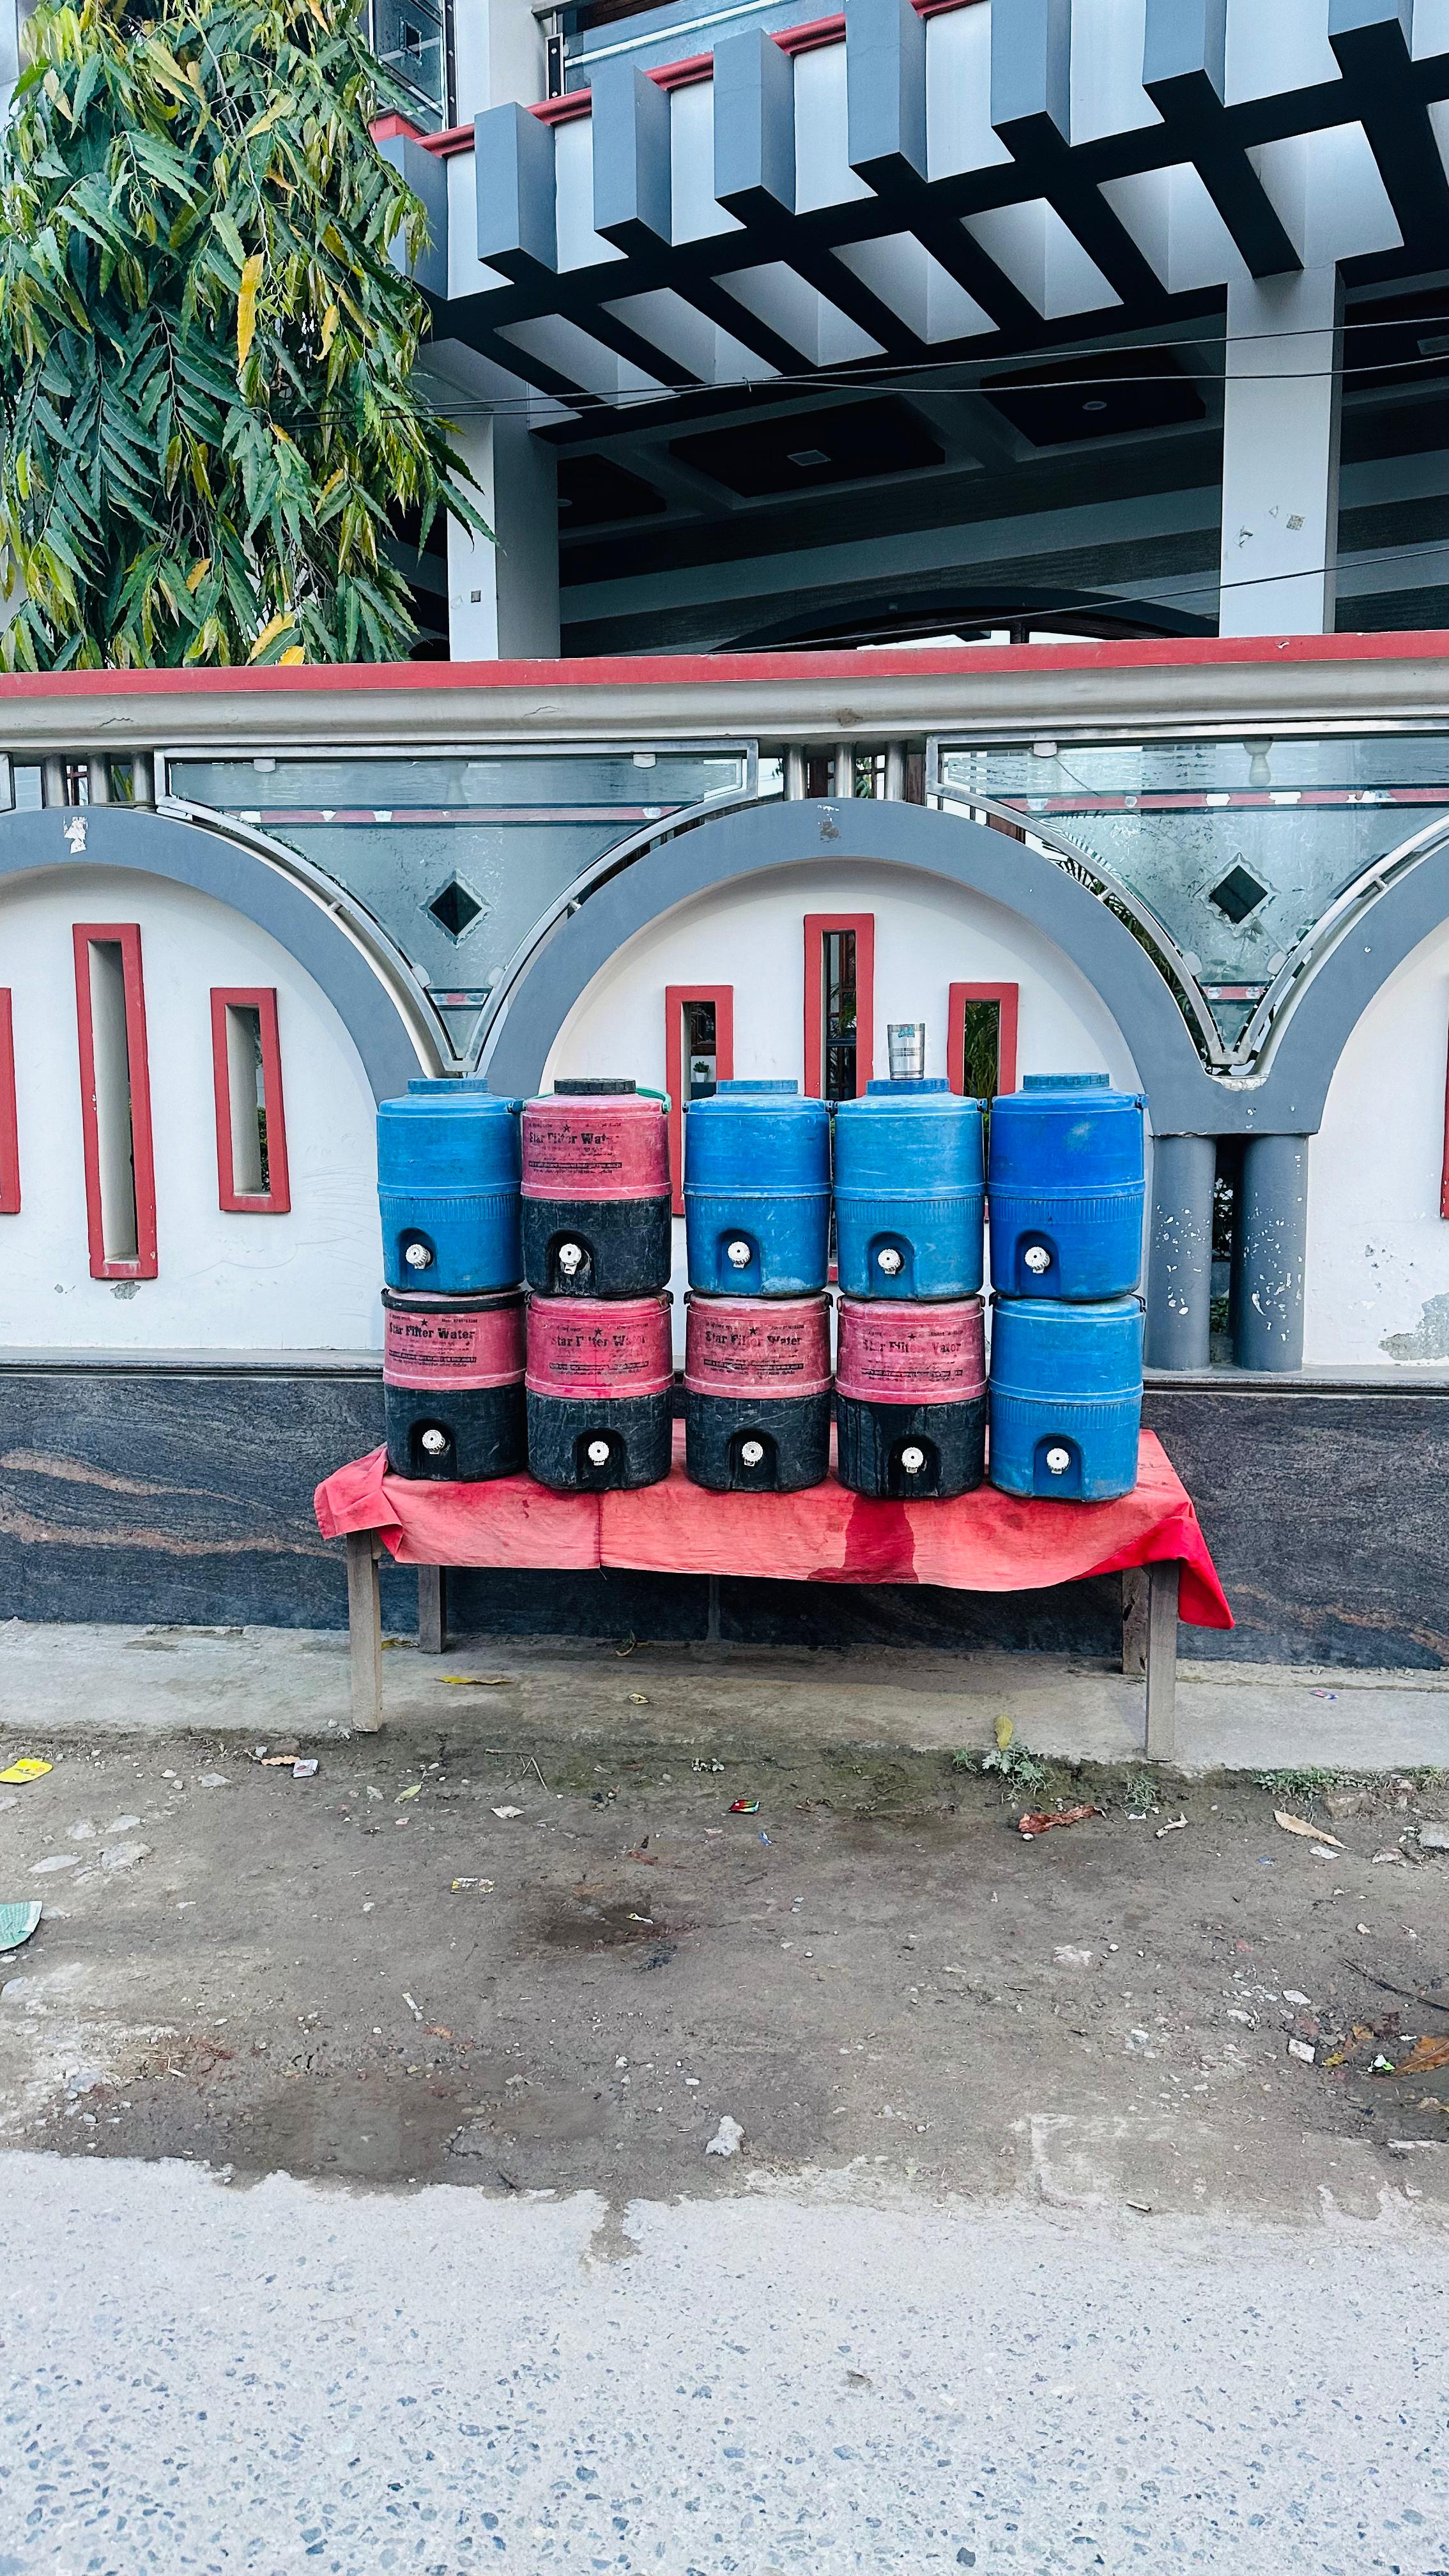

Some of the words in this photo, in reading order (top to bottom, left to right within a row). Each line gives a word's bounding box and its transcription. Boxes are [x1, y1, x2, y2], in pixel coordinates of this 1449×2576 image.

[389, 1322, 403, 1335] Star
[406, 1325, 434, 1338] Filter
[438, 1328, 475, 1339] Water
[551, 1335, 573, 1346] tar
[705, 1331, 727, 1344] Star
[767, 1335, 802, 1346] Water
